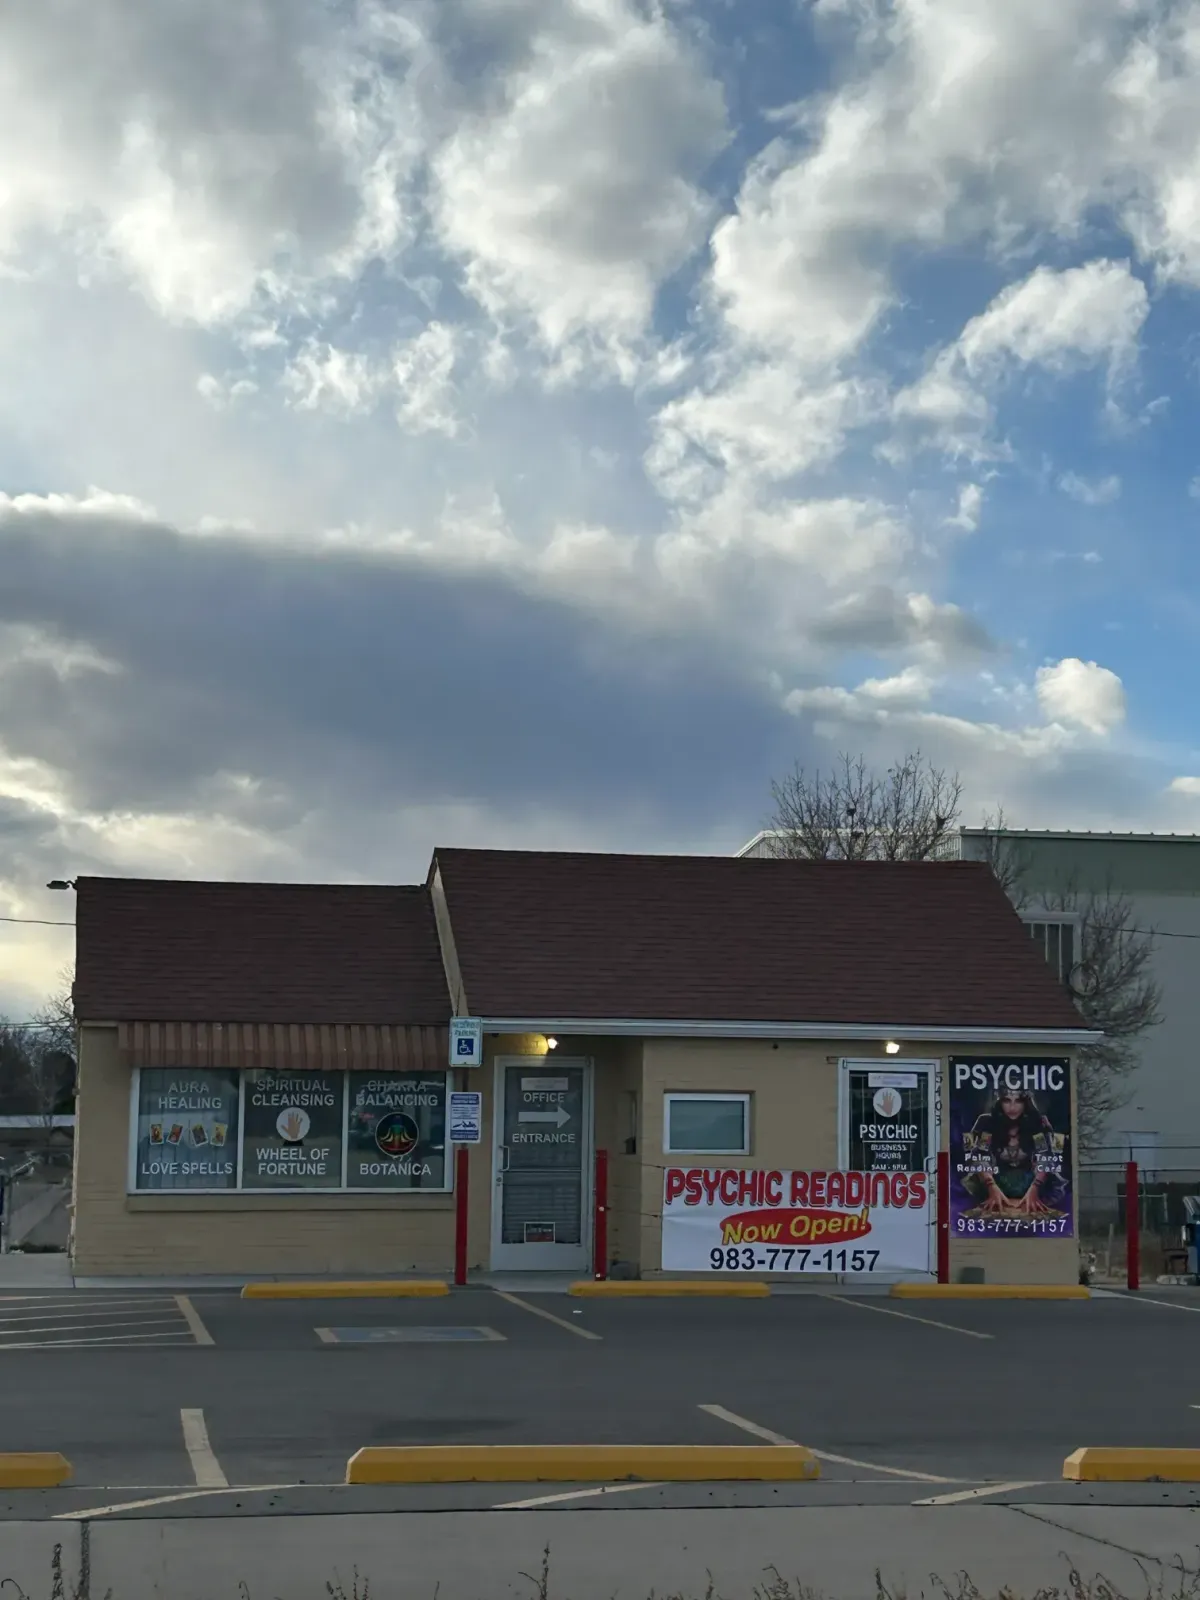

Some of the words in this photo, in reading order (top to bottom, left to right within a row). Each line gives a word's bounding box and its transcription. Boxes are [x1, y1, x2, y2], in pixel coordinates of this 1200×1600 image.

[955, 1064, 1064, 1091] PSYCHIC
[168, 1081, 209, 1093] AURA
[256, 1080, 331, 1091] SPIRITUAL
[158, 1097, 222, 1109] HEALING
[252, 1094, 335, 1106] CLEANSING
[355, 1094, 438, 1106] BALANCING
[523, 1092, 565, 1103] OFFICE
[860, 1124, 918, 1139] PSYCHIC
[512, 1133, 576, 1143] ENTRANCE
[256, 1148, 307, 1160] WHEEL
[310, 1148, 330, 1160] OF
[964, 1153, 991, 1162] Palm
[1035, 1154, 1064, 1163] Tarot
[142, 1162, 178, 1175] LOVE
[181, 1162, 233, 1175] SPELLS
[258, 1163, 326, 1175] FORTUNE
[956, 1164, 999, 1175] Reading
[1037, 1165, 1062, 1173] Card
[665, 1168, 783, 1206] PSYCHIC
[790, 1171, 927, 1209] READINGS
[722, 1221, 782, 1245] Now
[789, 1208, 870, 1240] Open!
[957, 1218, 1067, 1233] 983-777-1157
[709, 1247, 881, 1272] 983-777-1157
